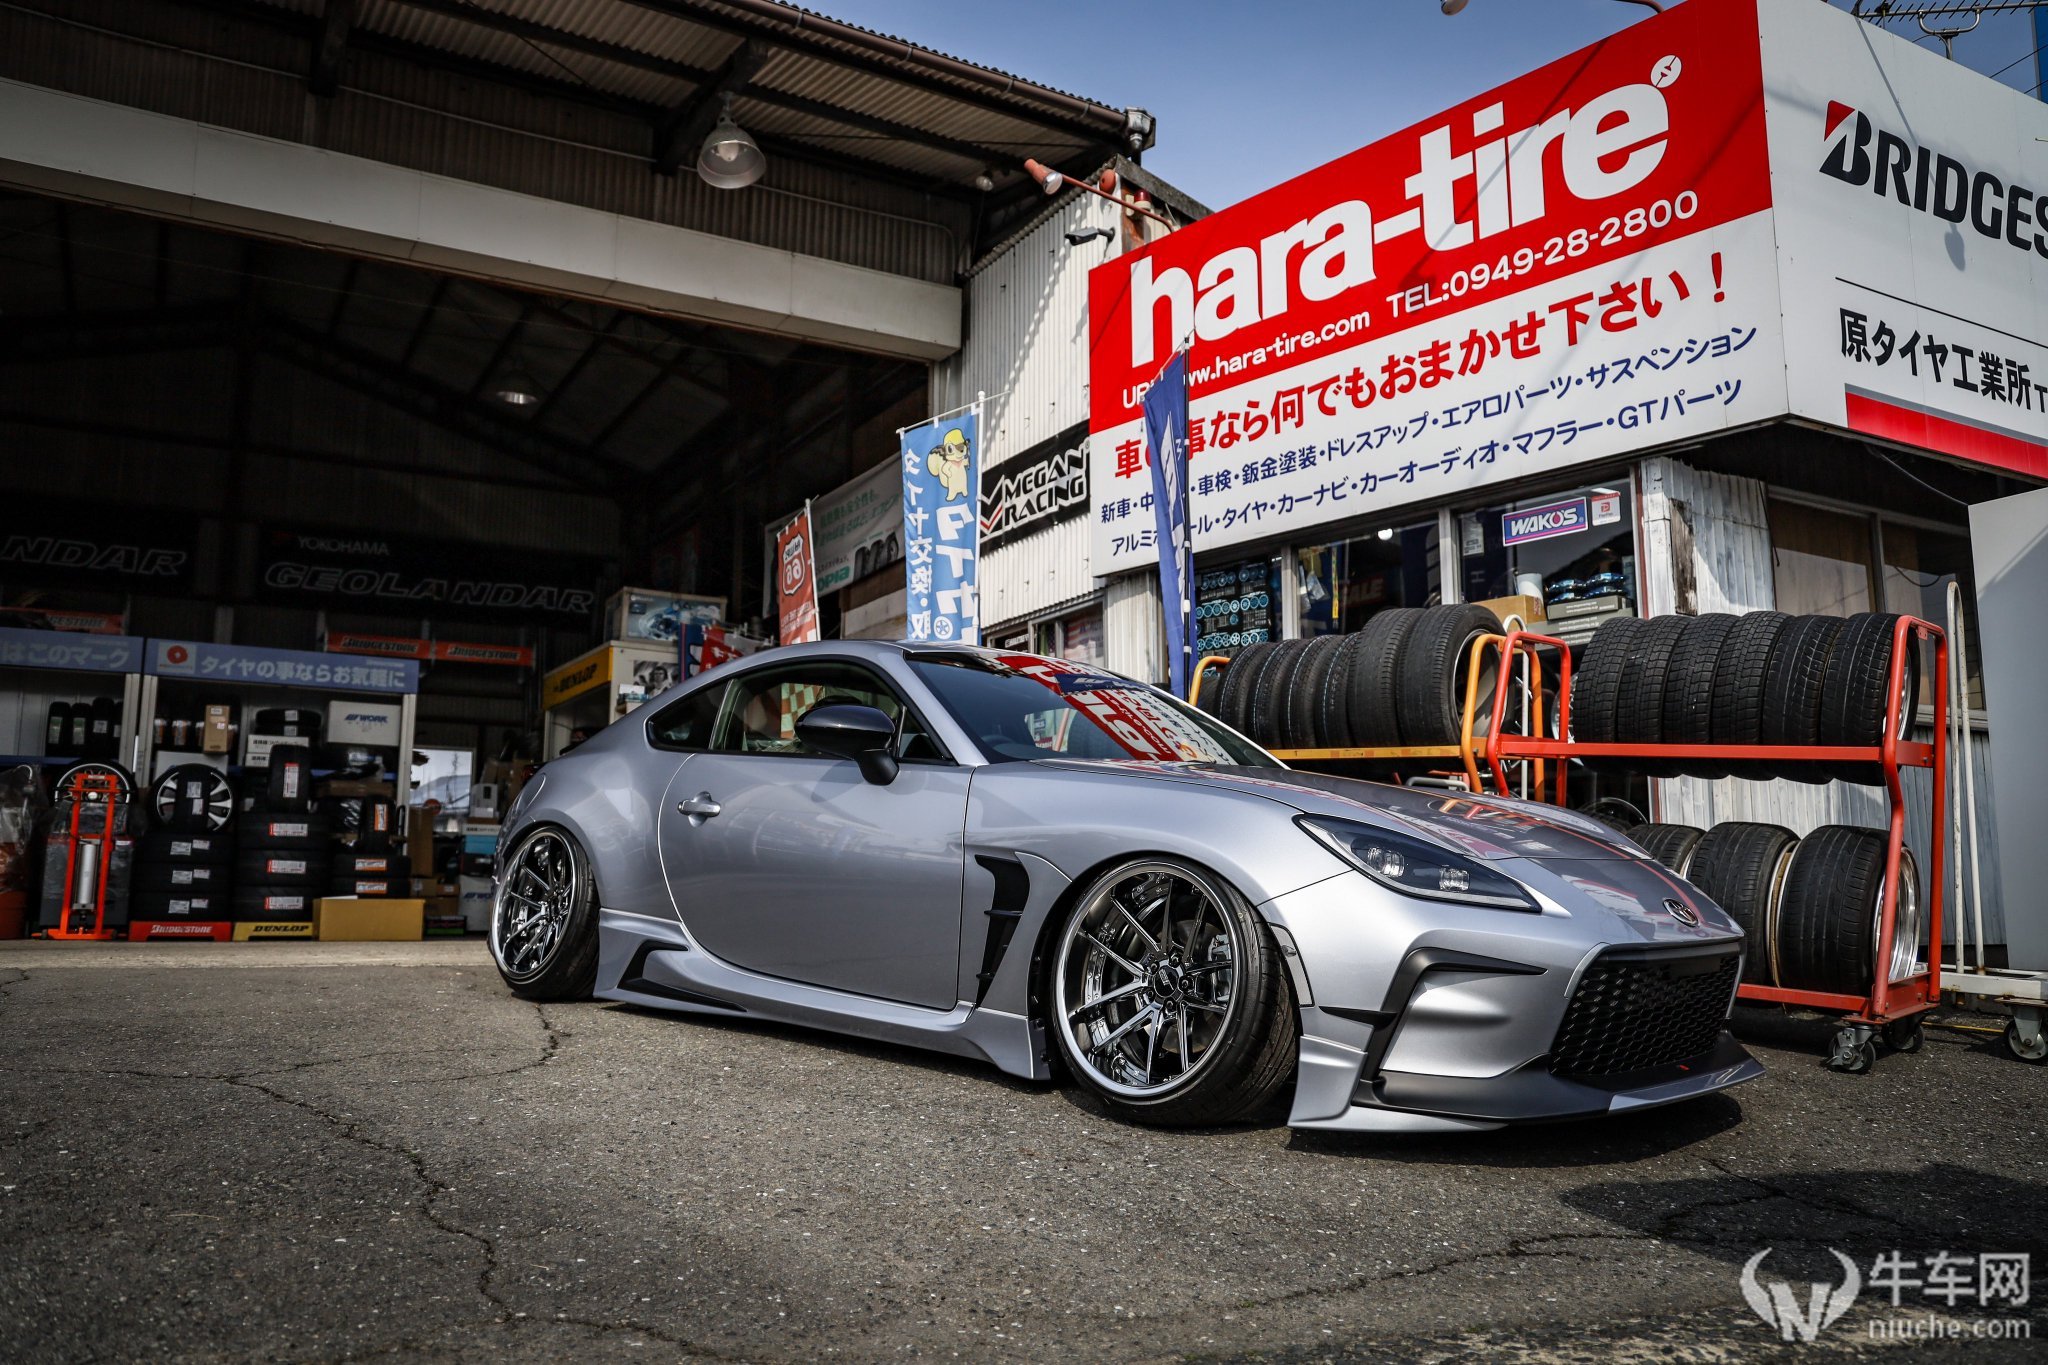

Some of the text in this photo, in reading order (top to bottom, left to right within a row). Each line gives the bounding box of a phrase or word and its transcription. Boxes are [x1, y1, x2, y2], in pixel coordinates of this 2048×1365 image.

[1130, 84, 1669, 368] hara-tire
[1385, 189, 1699, 318] TEL:0949-28-2800
[1184, 310, 1370, 387] ww.hara-tire.com
[1840, 307, 2032, 411] 原タイヤ工業所
[1101, 327, 1757, 524] 新車・中・車検・鈑金塗装・ドレスアップ・エアロパーツ・サスペンション
[1004, 448, 1086, 503] MEGAN
[1112, 379, 1742, 557] アルミル・タイヤ・カーナビ・カーオーディオ・マフラー・GTパーツ
[1004, 474, 1087, 528] RACING
[1511, 507, 1578, 537] WAKO'S
[1, 535, 188, 576] NDAR
[298, 535, 390, 556] YOKOHAMA
[264, 561, 594, 615] GEOLANDAR
[342, 635, 417, 653] BRIDGESTONE
[448, 645, 520, 661] BRIDGESTONE
[201, 655, 405, 688] タイヤの事ならお気軽に
[151, 924, 213, 934] BRIDGESTONE
